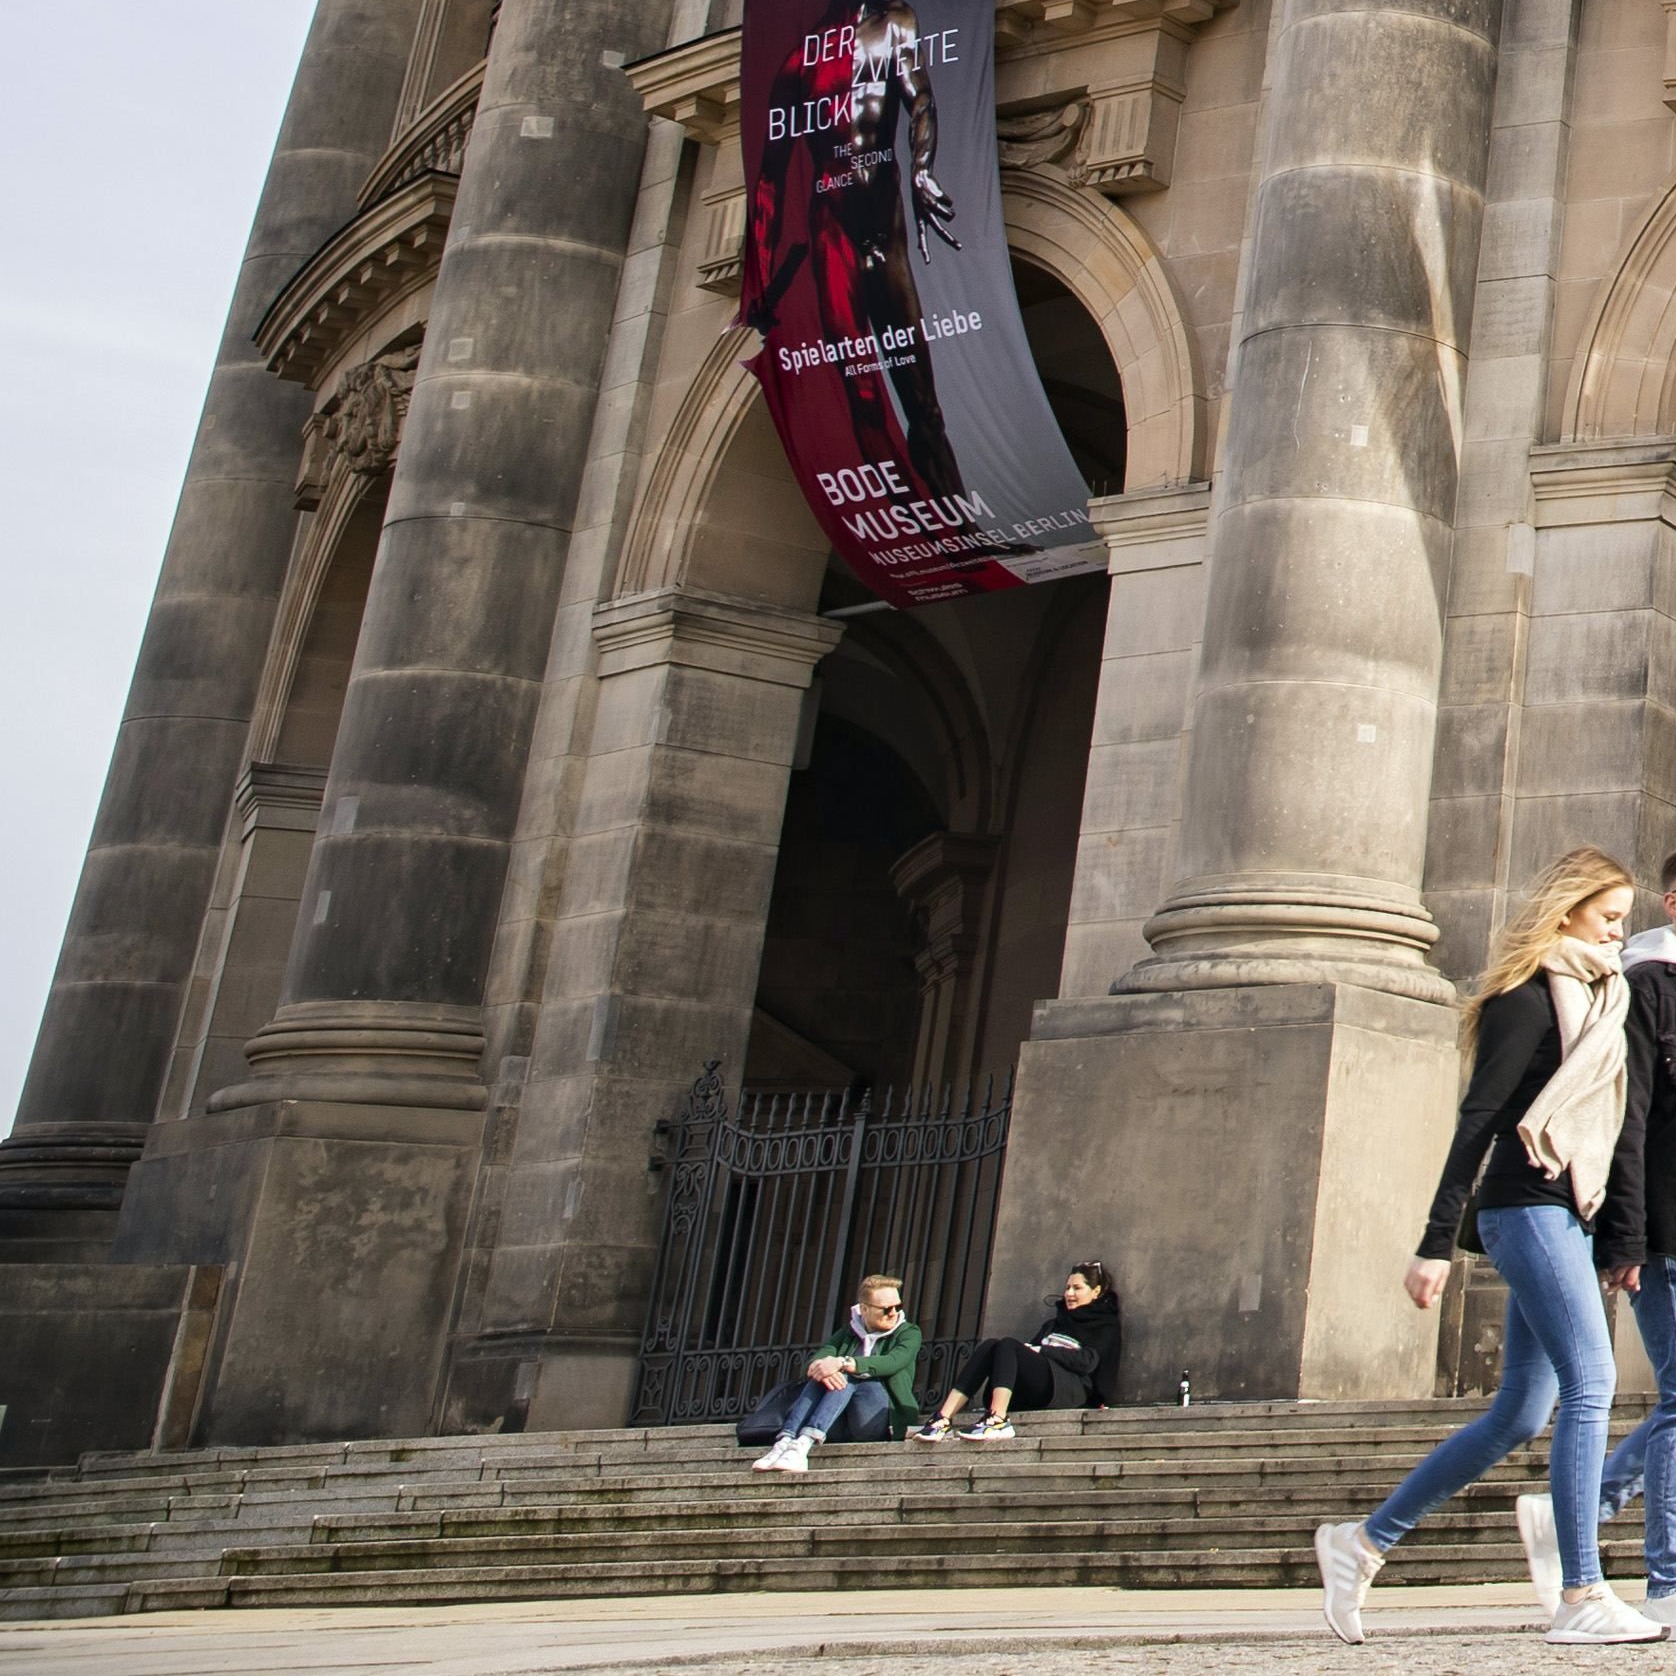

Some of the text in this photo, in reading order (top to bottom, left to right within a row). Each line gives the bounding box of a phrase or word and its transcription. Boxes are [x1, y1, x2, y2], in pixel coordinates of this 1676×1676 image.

[803, 25, 855, 67] DER
[851, 29, 959, 88] ZWEITE
[769, 92, 852, 141] BLICK
[833, 142, 853, 159] THE
[850, 148, 893, 170] SECOND
[816, 172, 853, 193] GLANCE
[779, 309, 983, 375] Spielarten der Liebe
[845, 353, 917, 377] All Forms of Love
[817, 460, 910, 506] BODE
[841, 490, 997, 543] MUSEUM
[869, 528, 1016, 567] MUSEUMSINSEL
[1013, 508, 1089, 539] BERLIN
